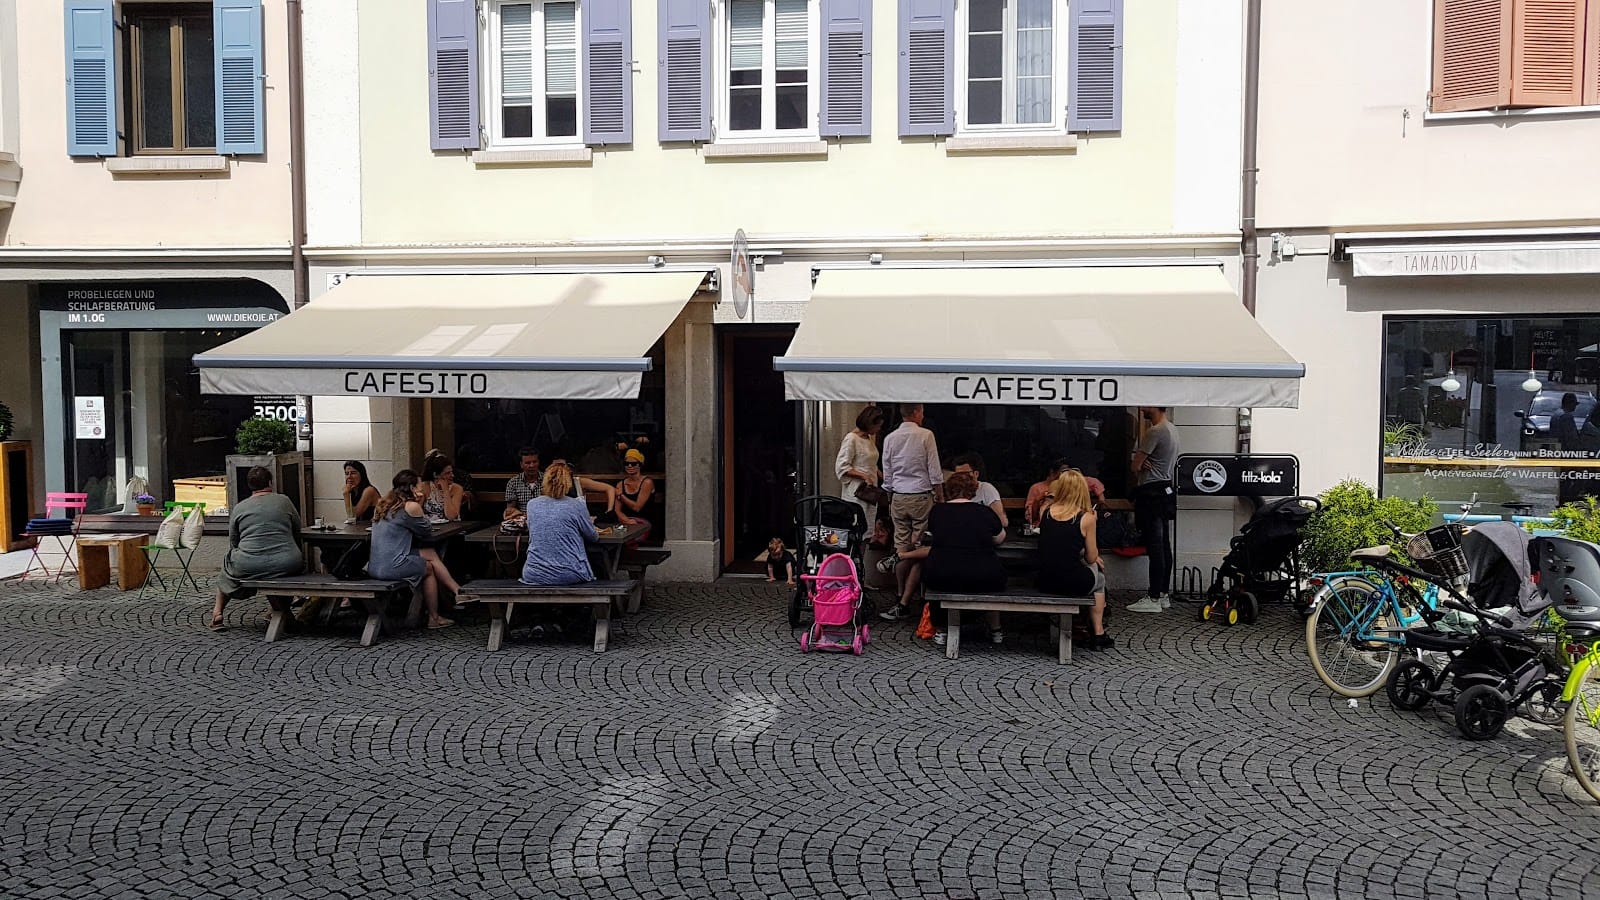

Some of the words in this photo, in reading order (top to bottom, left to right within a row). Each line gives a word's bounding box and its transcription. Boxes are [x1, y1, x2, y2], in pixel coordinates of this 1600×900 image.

[333, 274, 341, 285] 3
[67, 290, 132, 299] PROBELIEGEN
[134, 290, 155, 299] UND
[67, 301, 156, 311] SCHLAFBERATUNG
[68, 313, 80, 323] IM
[207, 313, 280, 322] WWW.DIEKOJE.AT
[344, 371, 488, 394] CAFESITO
[953, 376, 1119, 401] CAFESITO
[1539, 448, 1589, 459] BROWNIE
[1241, 470, 1282, 483] fritz-kola
